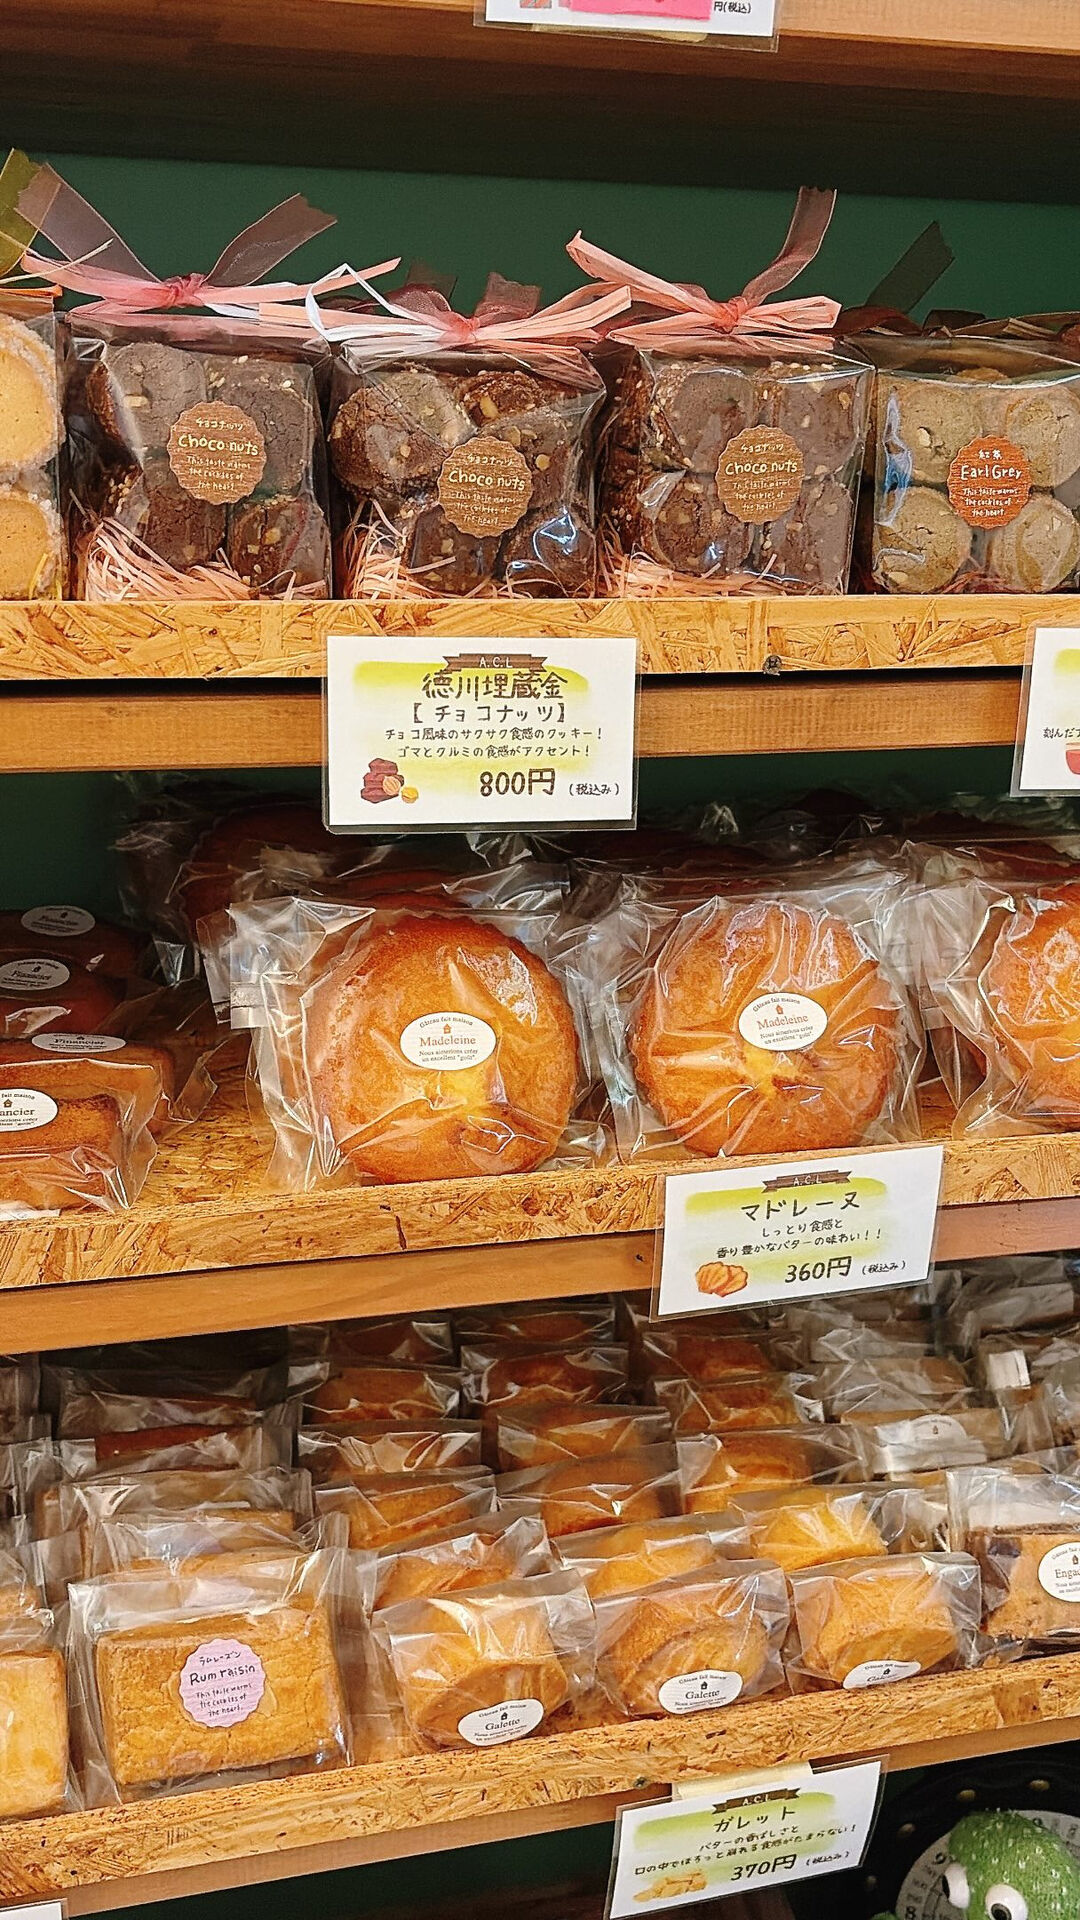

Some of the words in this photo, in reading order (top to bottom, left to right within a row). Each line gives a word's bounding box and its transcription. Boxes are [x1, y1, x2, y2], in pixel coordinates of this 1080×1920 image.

[178, 434, 225, 451] Choco
[229, 441, 258, 456] nuts
[187, 456, 203, 465] This
[978, 449, 1002, 460] 紅茶
[725, 462, 767, 475] Choco
[771, 460, 798, 472] nuts
[961, 464, 989, 480] Earl
[992, 464, 1021, 479] Grey
[448, 468, 493, 486] Choco
[497, 477, 525, 491] nuts
[479, 657, 513, 668] A.C.L
[421, 670, 568, 701] 徳川埋蔵金
[479, 768, 555, 798] 800円
[569, 783, 620, 797] (税込み)
[757, 1015, 809, 1030] Madeleine
[420, 1036, 477, 1047] Madeleine
[793, 1175, 823, 1186] A.C.L
[741, 1191, 860, 1222] マドレーヌ
[762, 1218, 843, 1238] しっとり食感と
[785, 1255, 852, 1283] 360円
[861, 1260, 907, 1275] (税込み)
[199, 1651, 241, 1666] ラムレーズン
[189, 1672, 217, 1686] Rum
[220, 1665, 256, 1678] raisin
[685, 1690, 720, 1699] Galette
[485, 1718, 520, 1731] Galette
[713, 1806, 795, 1832] ガレット
[731, 1854, 797, 1881] 370円
